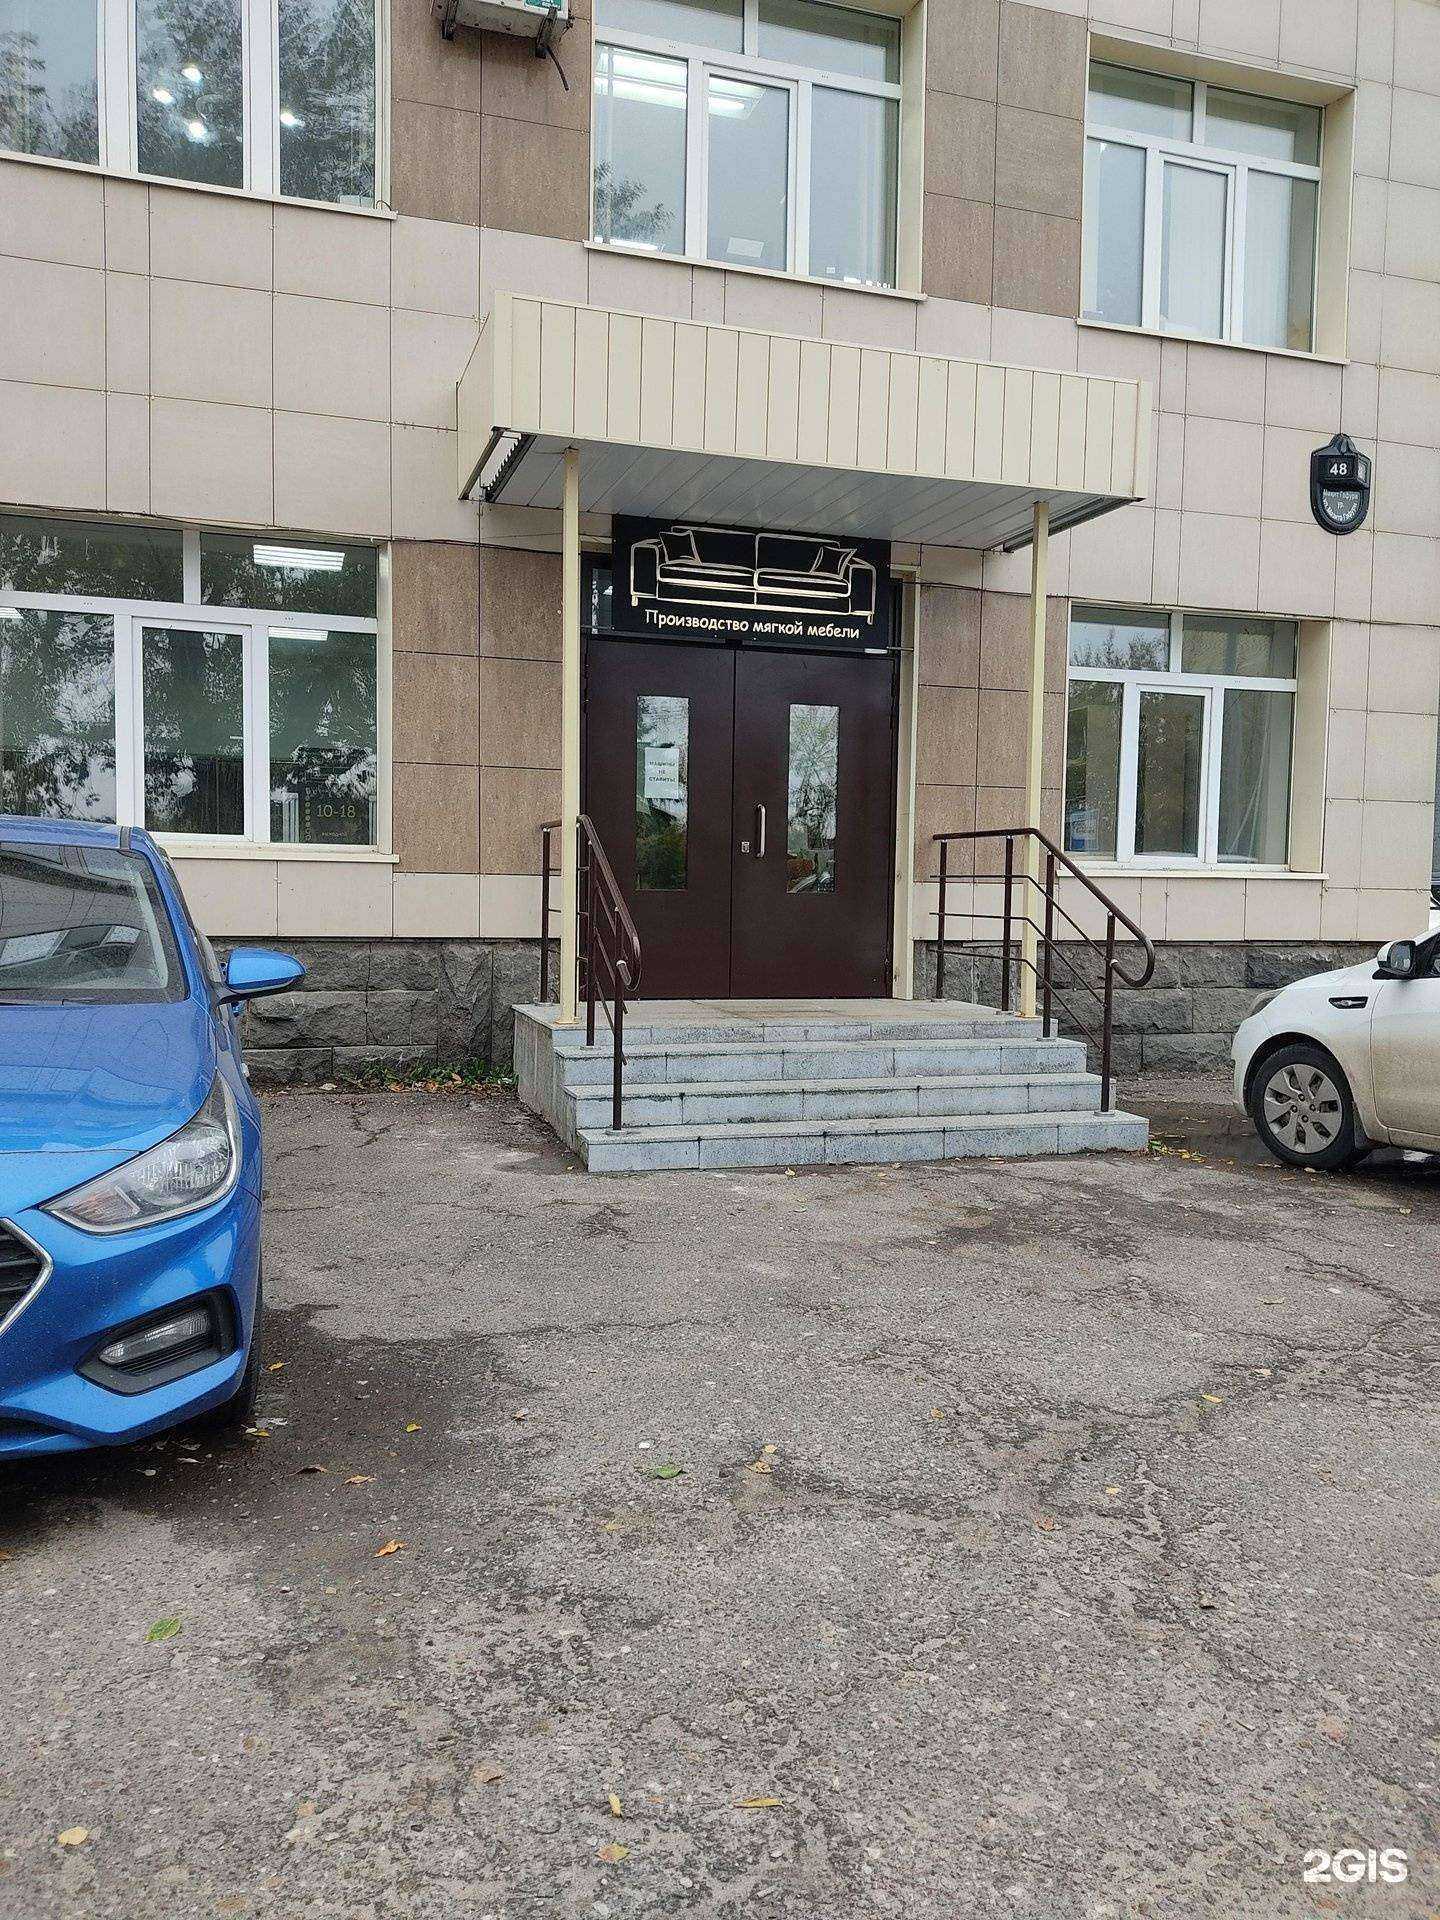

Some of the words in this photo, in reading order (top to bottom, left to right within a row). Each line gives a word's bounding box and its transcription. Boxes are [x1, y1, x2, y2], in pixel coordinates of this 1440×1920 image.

[1329, 462, 1347, 476] 48
[644, 608, 749, 631] Производство
[753, 620, 804, 636] мягкой
[807, 622, 861, 640] мебели
[316, 804, 356, 818] 10-18
